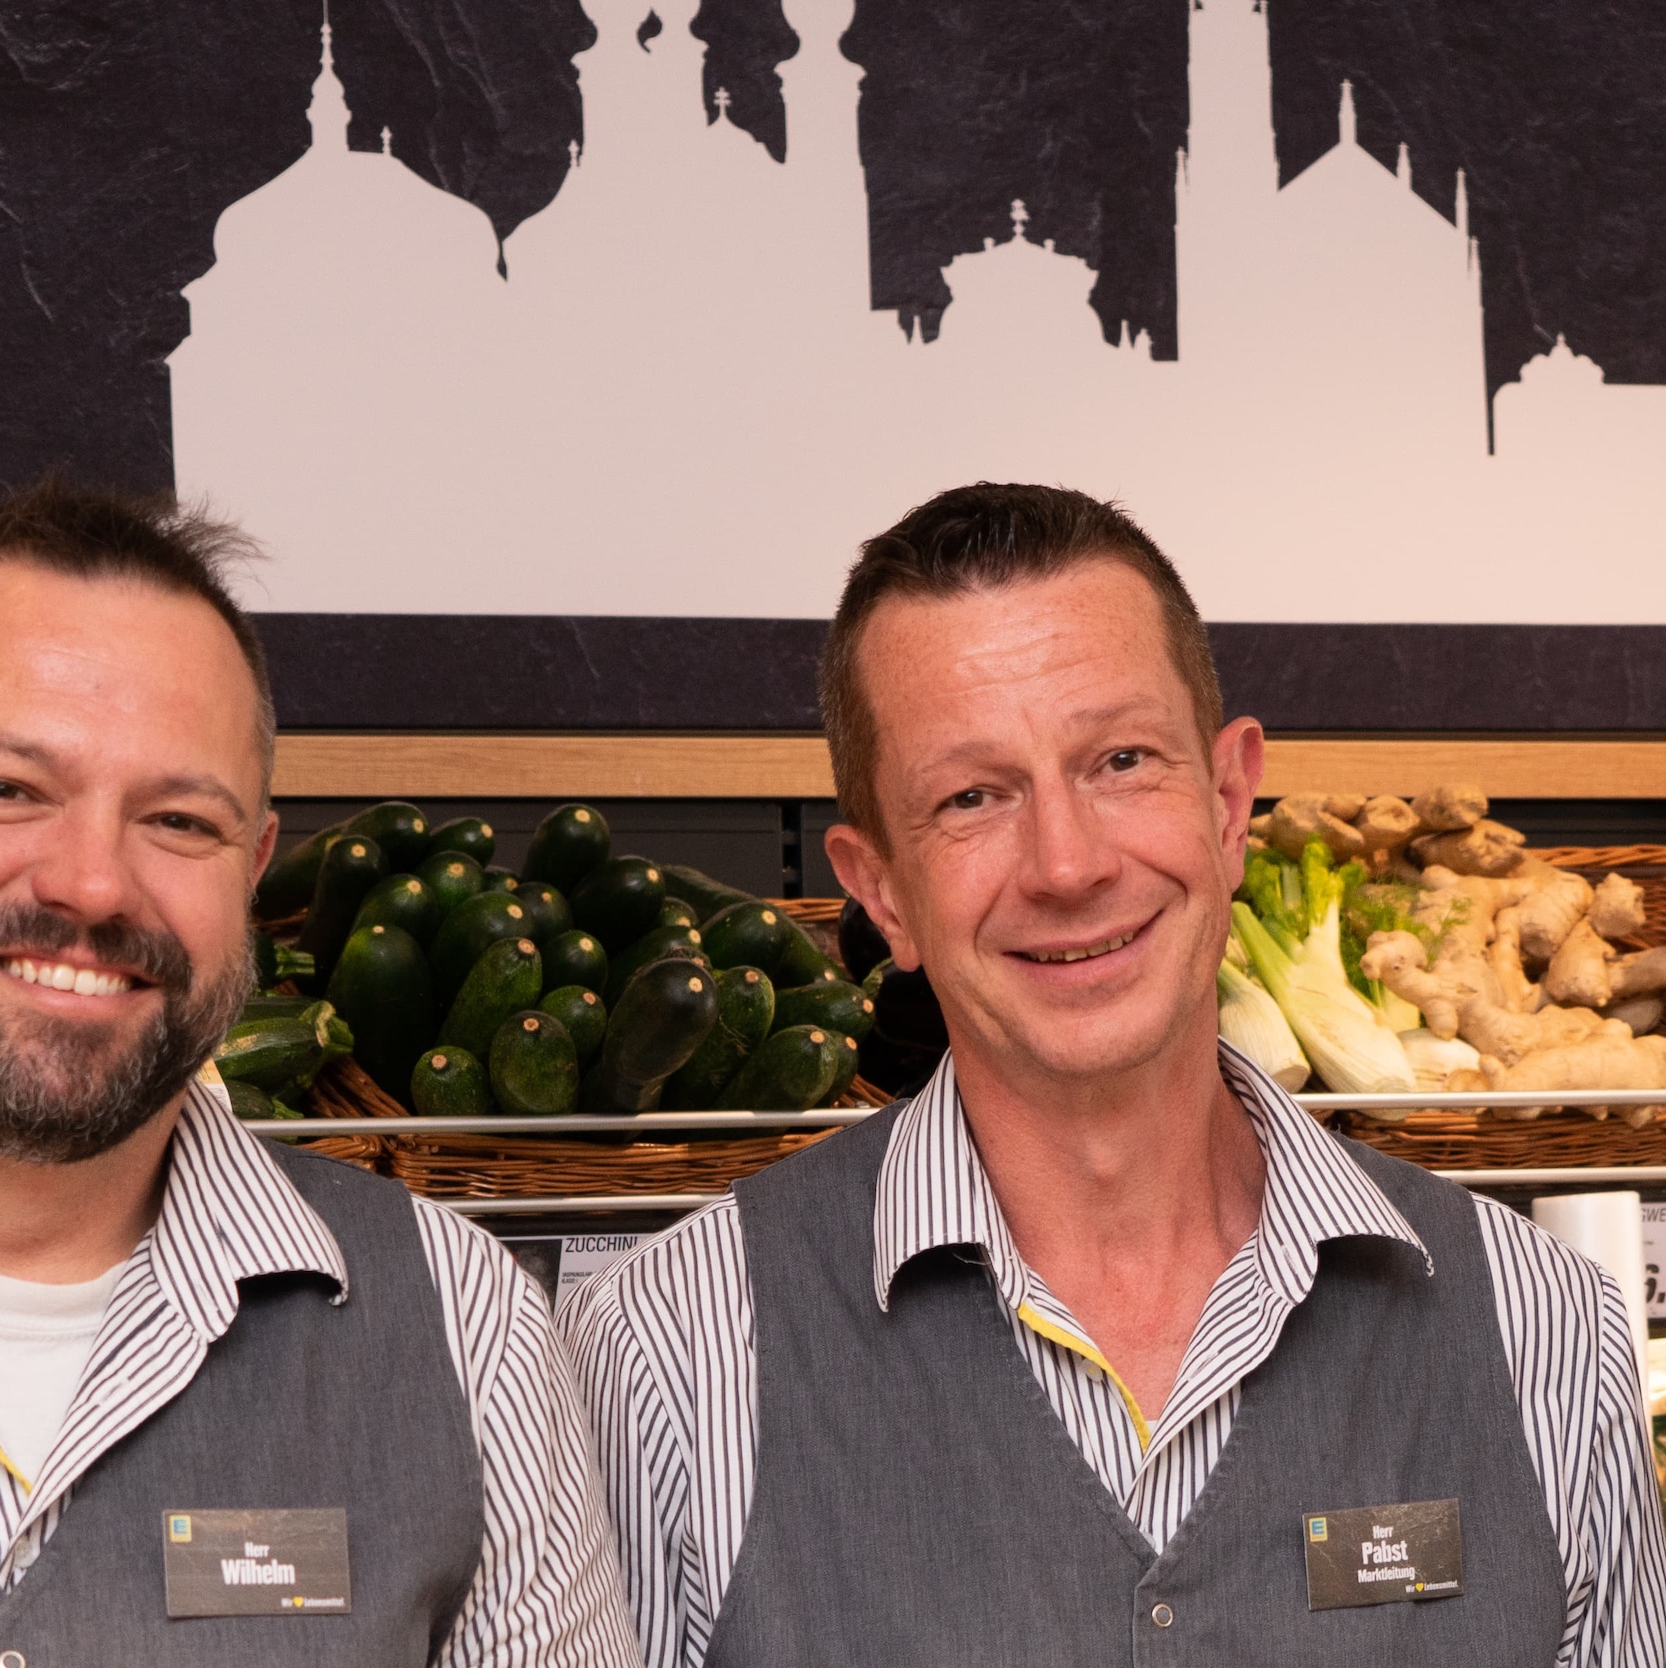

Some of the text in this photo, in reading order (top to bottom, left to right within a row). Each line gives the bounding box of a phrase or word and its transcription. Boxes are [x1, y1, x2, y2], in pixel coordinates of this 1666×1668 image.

[1372, 1525, 1394, 1539] Herr
[244, 1542, 270, 1558] Herr
[1362, 1540, 1408, 1565] Pabst
[221, 1559, 295, 1585] Wilhelm
[1358, 1566, 1415, 1583] Marktleitung
